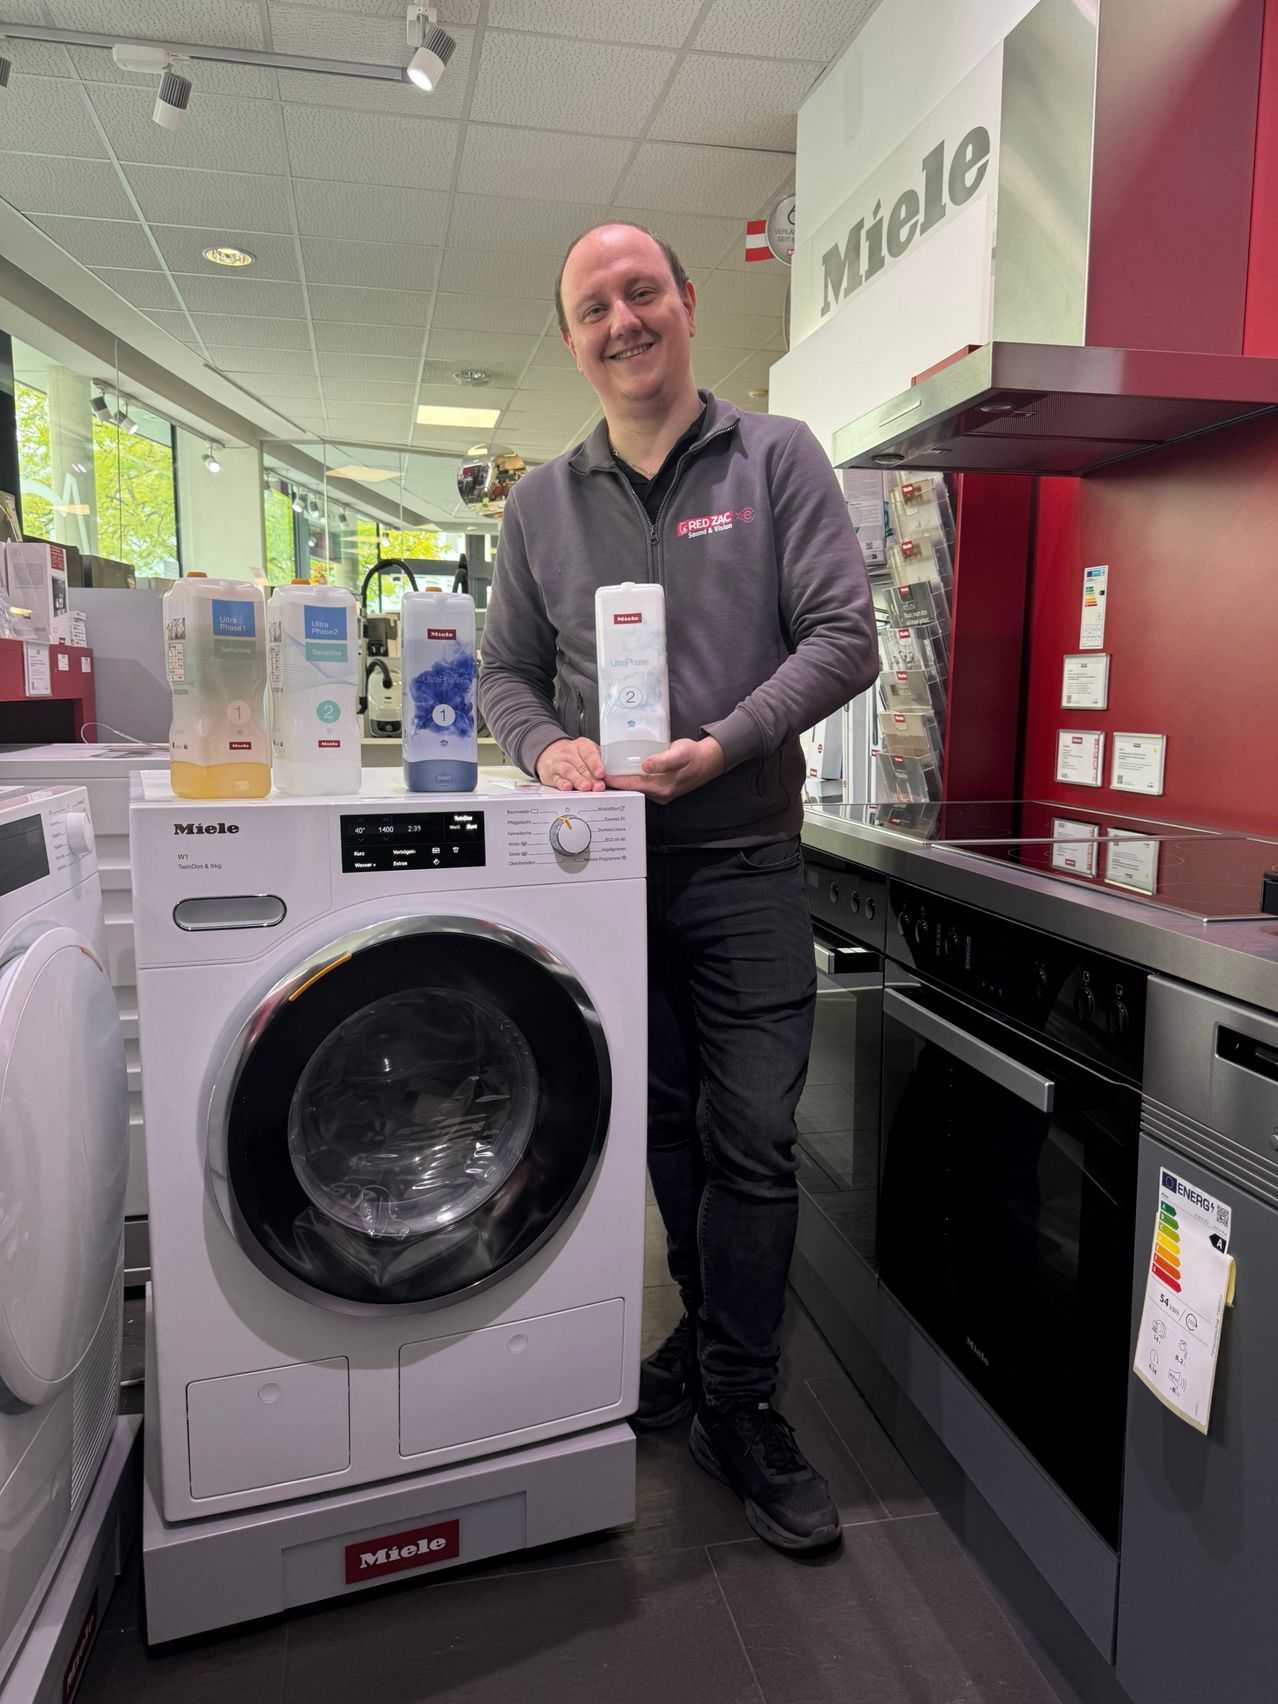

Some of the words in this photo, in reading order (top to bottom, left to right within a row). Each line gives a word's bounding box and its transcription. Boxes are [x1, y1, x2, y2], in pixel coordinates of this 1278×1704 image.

[821, 125, 990, 317] Miele
[688, 519, 709, 530] RED
[711, 512, 731, 525] ZAC
[688, 528, 707, 538] Sound
[714, 523, 733, 532] Vision
[219, 616, 237, 624] Ultra
[311, 620, 329, 628] Ultra
[221, 646, 251, 654] Sensitive
[312, 649, 342, 657] Sensitive
[611, 659, 648, 667] UltraPhase
[422, 675, 464, 684] UltraPhase
[626, 690, 635, 704] 2
[235, 706, 241, 719] 1
[323, 705, 333, 719] 2
[439, 709, 447, 722] 1
[173, 823, 239, 835] Miele
[1177, 1182, 1210, 1212] ENERG
[1216, 1238, 1223, 1249] A
[1159, 1293, 1169, 1307] 54
[966, 1335, 989, 1366] Miele
[359, 1532, 447, 1569] Miele
